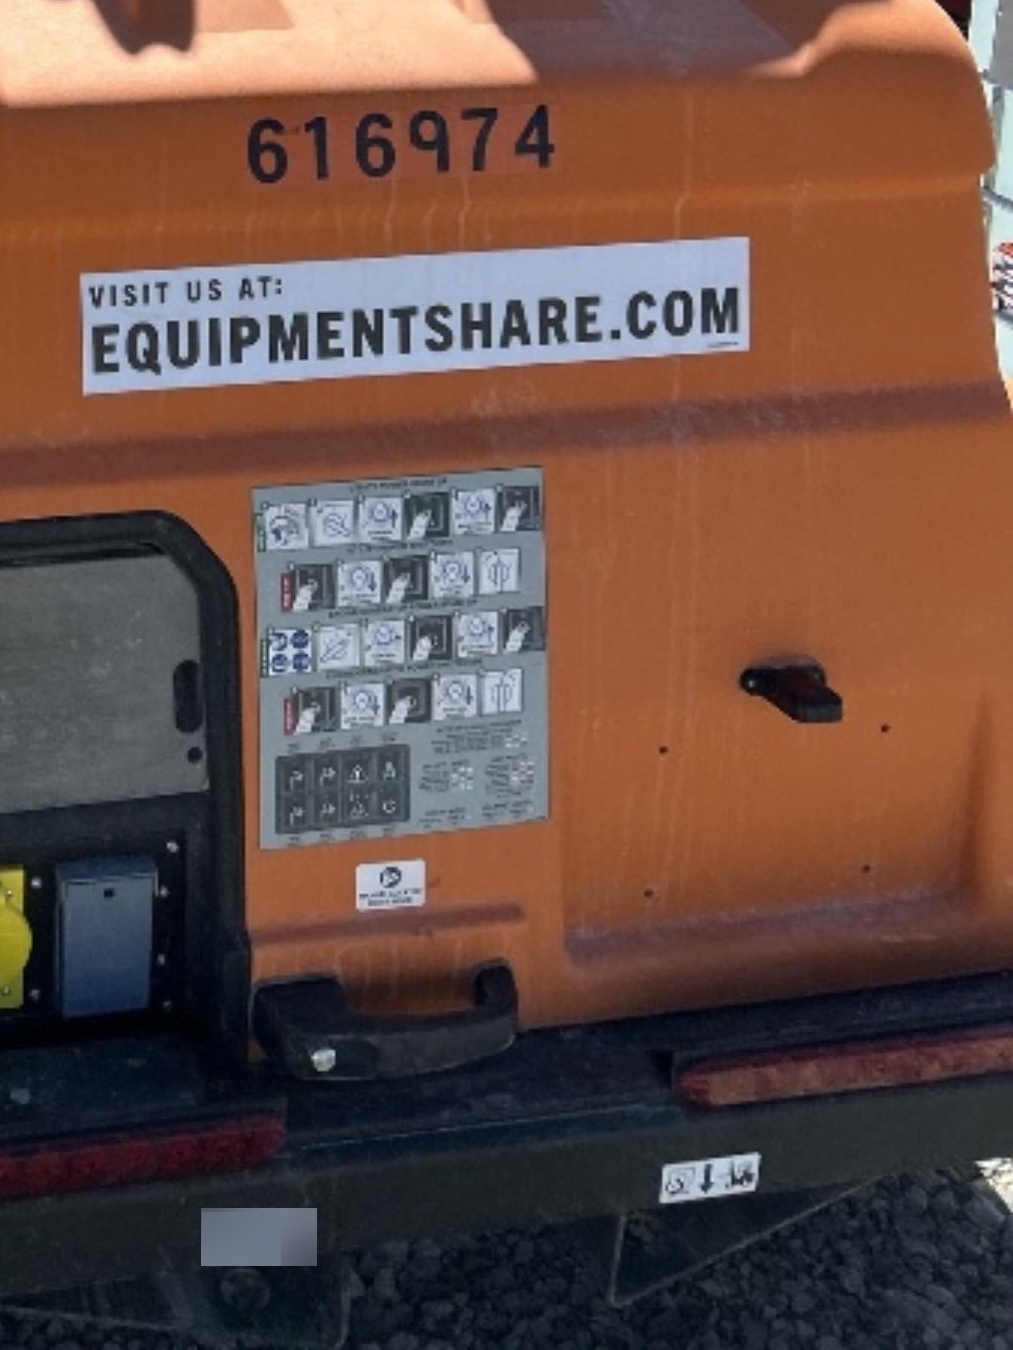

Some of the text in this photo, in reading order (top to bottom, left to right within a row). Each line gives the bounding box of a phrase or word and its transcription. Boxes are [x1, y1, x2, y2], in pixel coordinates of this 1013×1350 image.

[246, 104, 555, 184] 616974
[89, 275, 283, 308] VISIT US AT:
[91, 287, 739, 375] EQUIPMENTSHARE.COM
